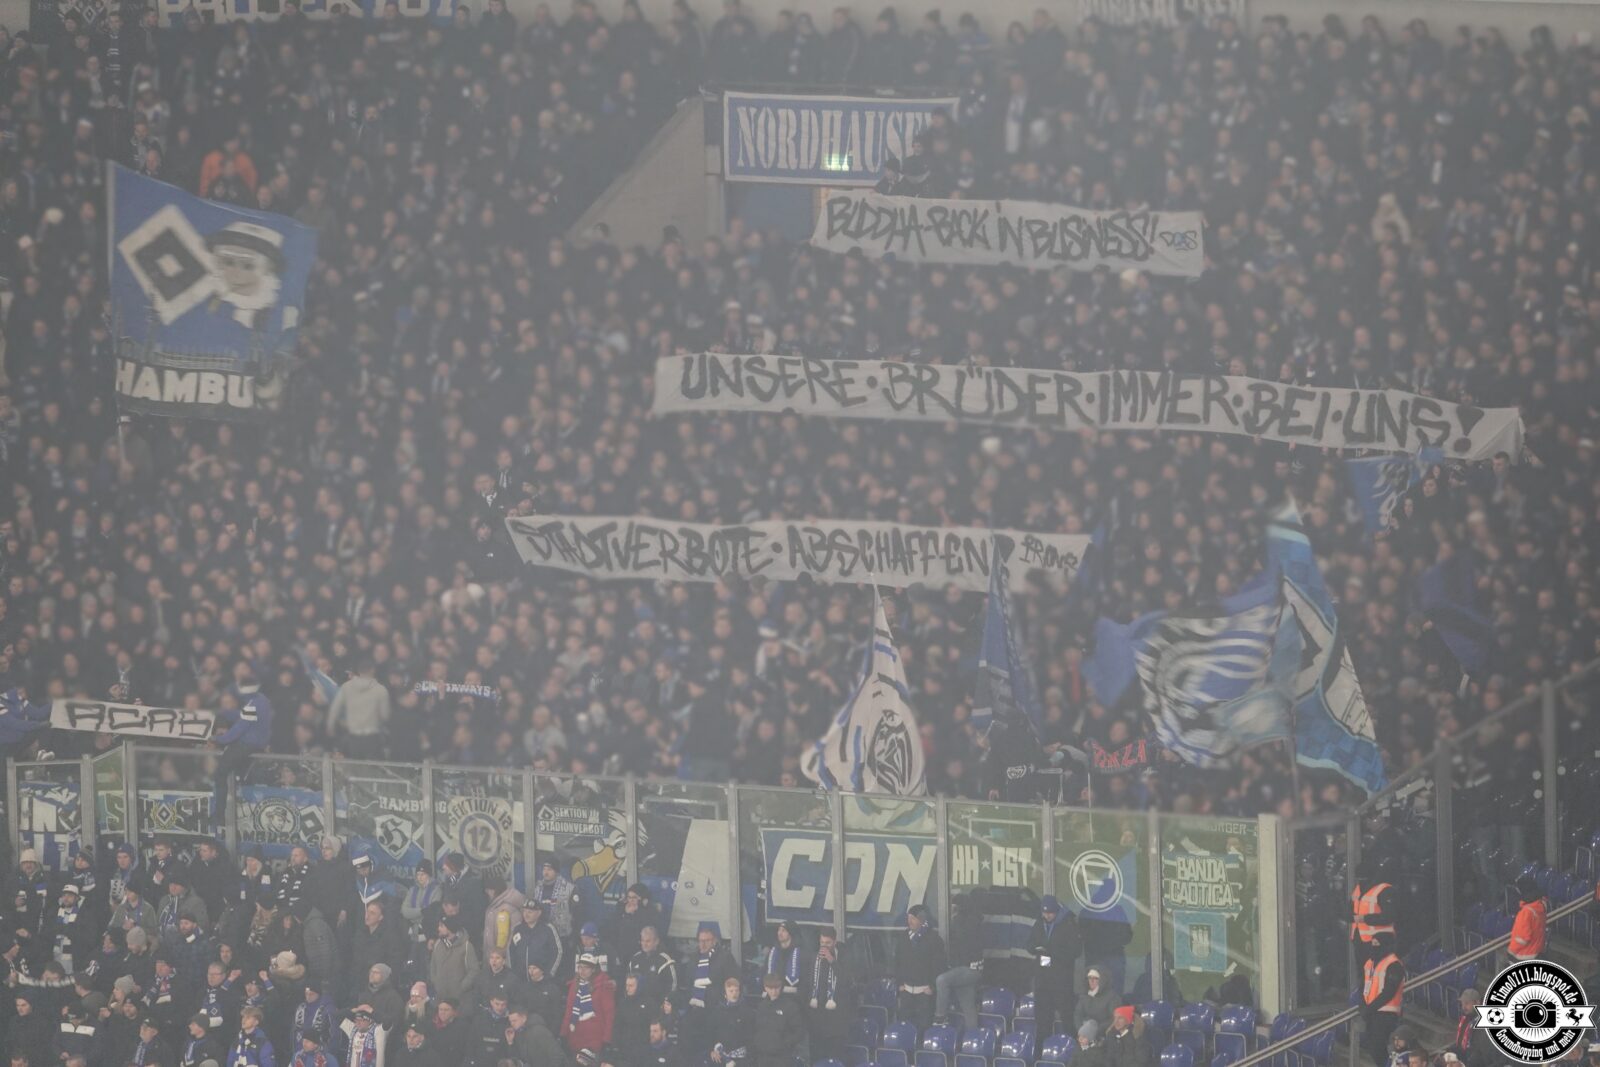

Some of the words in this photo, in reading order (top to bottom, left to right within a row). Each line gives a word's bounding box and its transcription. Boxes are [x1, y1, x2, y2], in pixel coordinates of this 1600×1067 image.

[116, 357, 260, 409] HAMBU
[680, 352, 867, 408] UNSERE
[880, 361, 1094, 426] BRÜDER
[1097, 370, 1240, 426] IMMER
[1243, 381, 1326, 440] BEI
[1344, 390, 1485, 454] UNS!
[65, 702, 212, 739] ACAB
[378, 795, 447, 814] HAMBG
[448, 798, 498, 826] SEKTION
[553, 807, 588, 819] SEKTION
[467, 824, 492, 852] 12
[539, 821, 604, 835] STADIONVERBOT
[771, 838, 938, 913] CDN
[952, 844, 979, 885] HH
[991, 846, 1032, 887] OST
[1176, 856, 1226, 882] BANDA
[1170, 880, 1233, 908] CAOTICA
